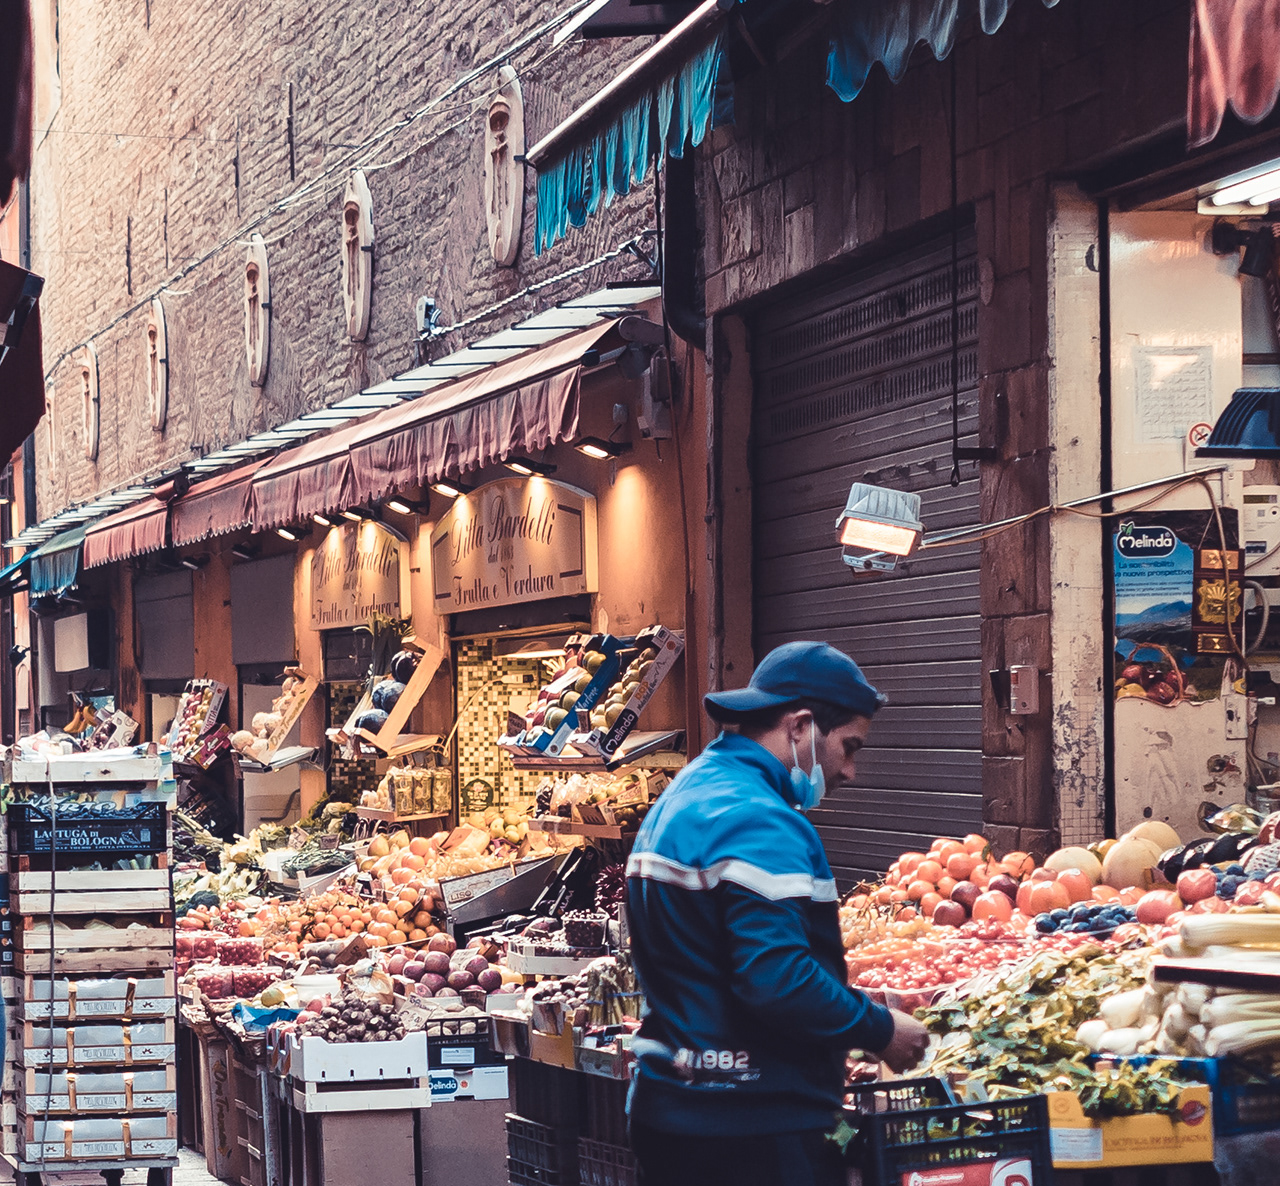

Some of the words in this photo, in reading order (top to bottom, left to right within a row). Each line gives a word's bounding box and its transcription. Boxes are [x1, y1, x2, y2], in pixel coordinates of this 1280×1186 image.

[451, 515, 484, 567] Ditta
[487, 495, 557, 546] Bardelli
[1120, 534, 1173, 549] Melinda
[452, 575, 489, 607] Frutta
[492, 583, 499, 603] e
[499, 564, 555, 598] Verdura
[316, 599, 343, 625] Frutta
[606, 712, 636, 756] Melinda
[70, 837, 126, 846] BOLOGNA
